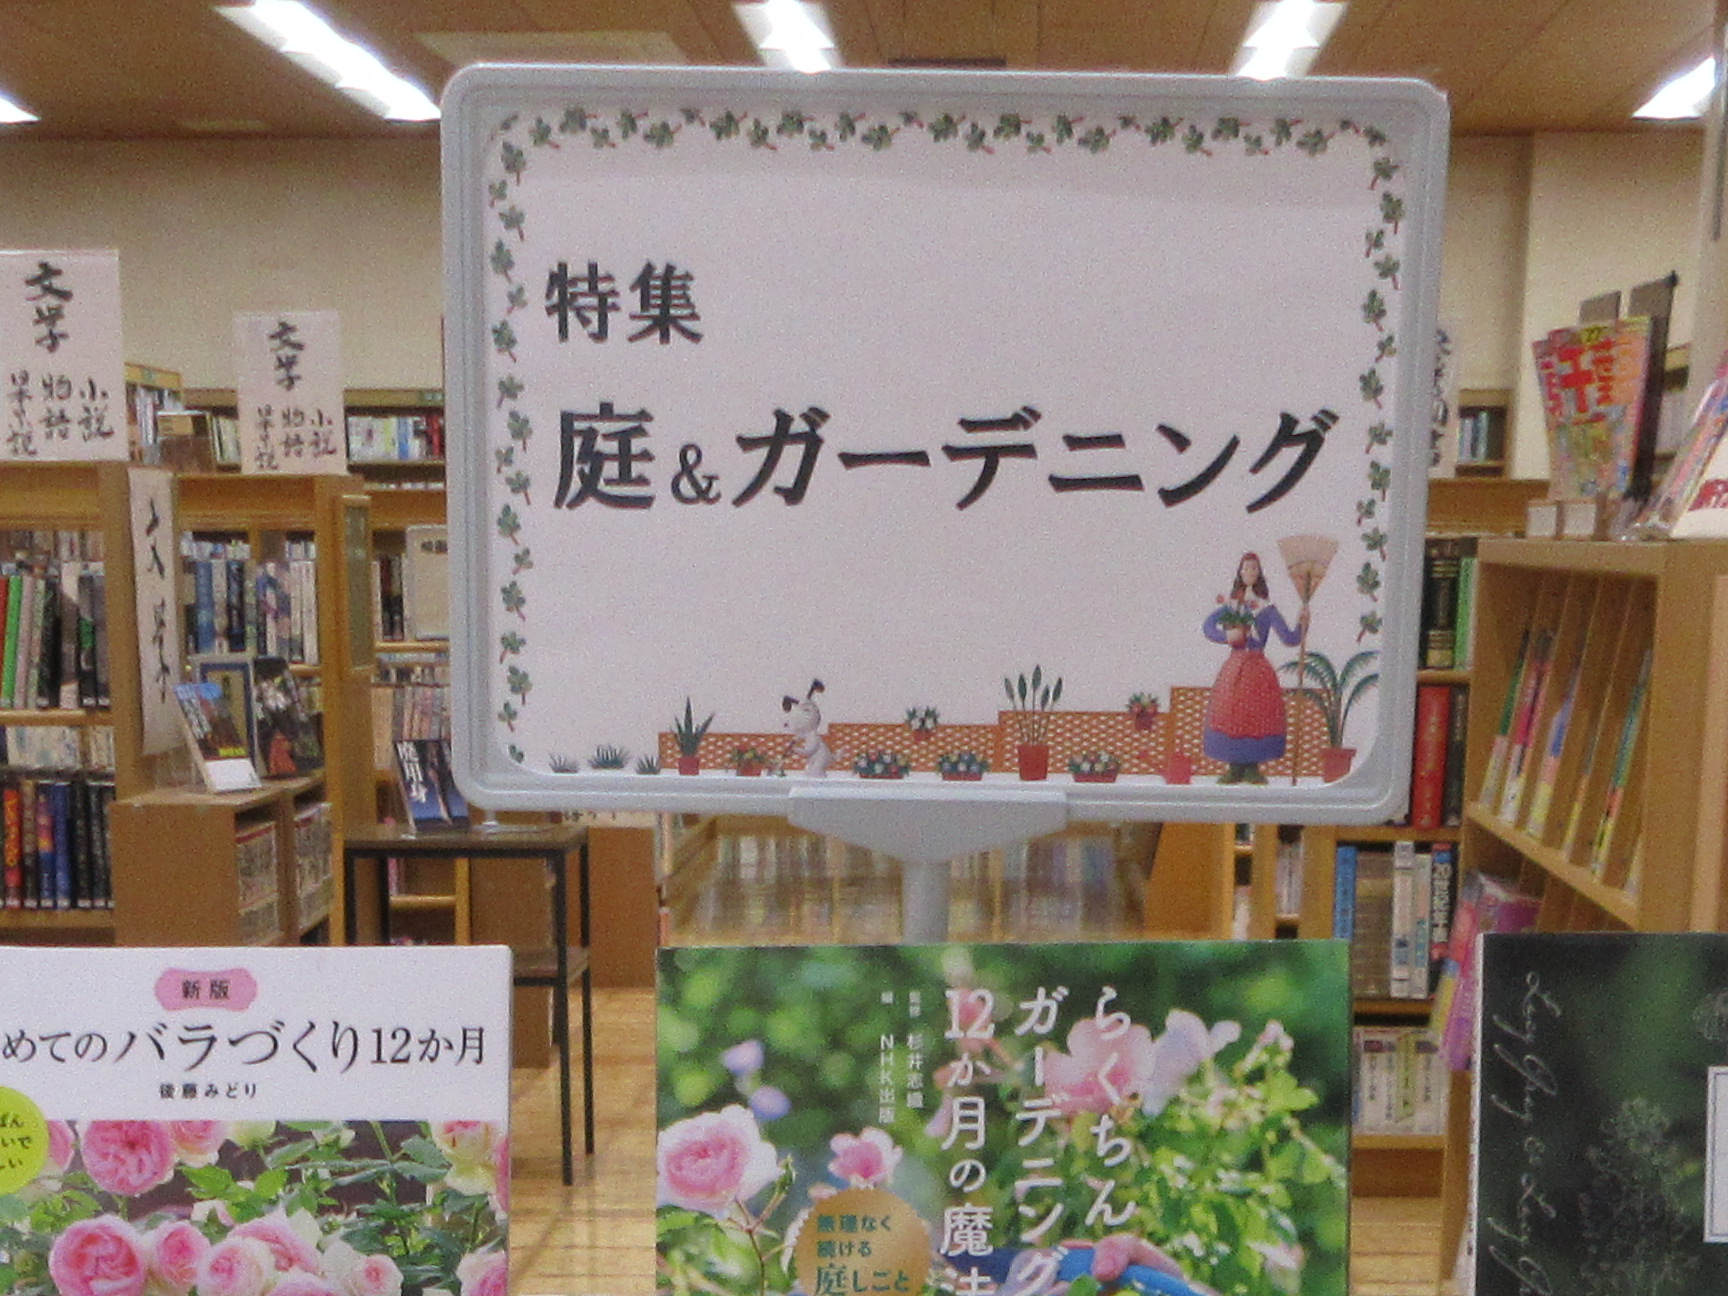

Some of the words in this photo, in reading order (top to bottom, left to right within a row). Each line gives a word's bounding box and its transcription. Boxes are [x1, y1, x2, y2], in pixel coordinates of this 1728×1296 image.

[25, 261, 73, 353] 文学
[545, 261, 704, 344] 特集
[269, 320, 305, 392] 文学
[553, 402, 1339, 515] 庭&ガーデニング
[181, 978, 231, 1000] 新版
[159, 1081, 258, 1099] 後藤みどり
[1086, 985, 1138, 1228] らくちん
[815, 1213, 892, 1236] 無理なく
[816, 1239, 874, 1260] 続ける
